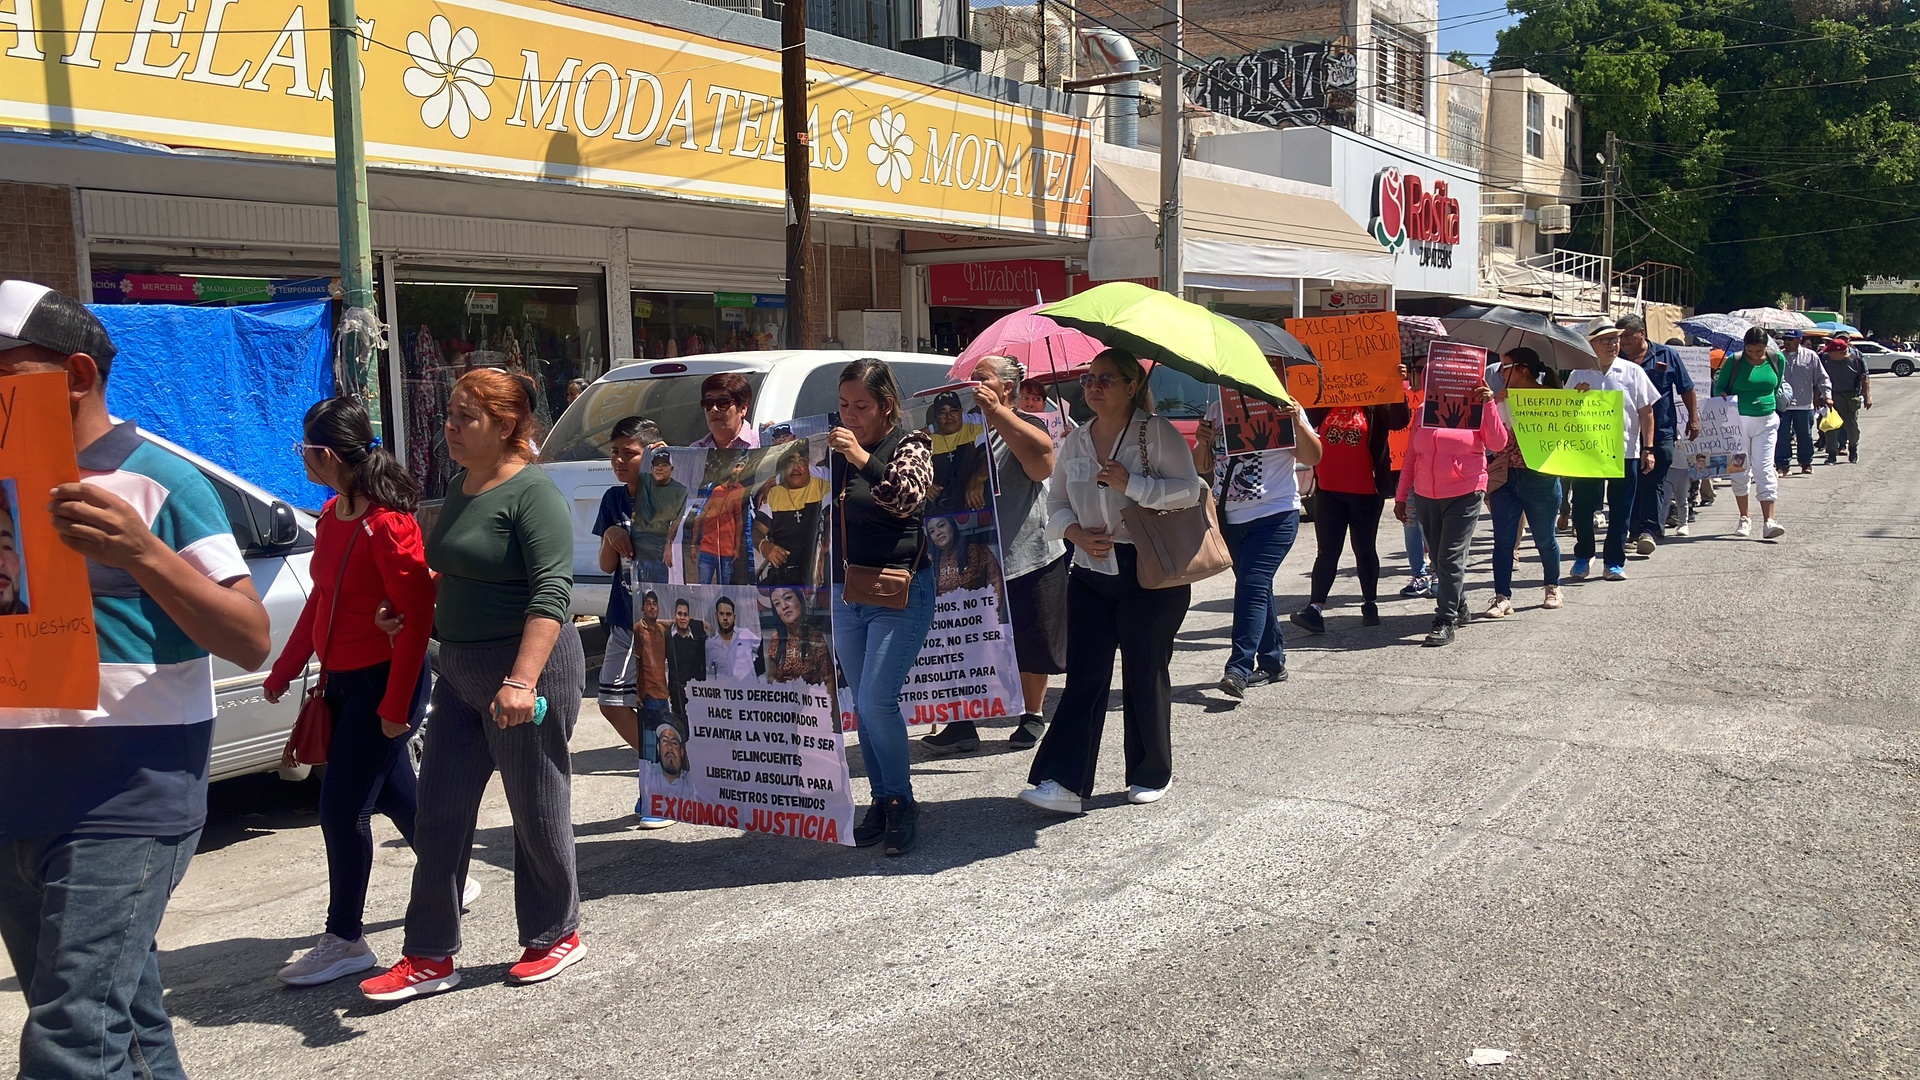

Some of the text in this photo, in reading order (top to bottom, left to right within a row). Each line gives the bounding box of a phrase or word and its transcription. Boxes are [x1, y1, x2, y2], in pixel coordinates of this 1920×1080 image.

[505, 49, 854, 172] MODATELAS
[1404, 174, 1460, 245] Rosita
[963, 262, 1039, 292] Elizabeth
[142, 283, 183, 291] MERCERÍA
[206, 285, 265, 294] MANUALIDADES
[279, 285, 326, 294] TEMPORADAS
[1346, 292, 1378, 305] Rosita
[1295, 314, 1385, 339] EXIGIMOS
[1304, 333, 1399, 362] IBERACION
[1298, 372, 1315, 387] De
[1565, 398, 1584, 407] PARA
[1587, 399, 1602, 407] LOS
[1518, 422, 1612, 433] ALTO AL GOBIERNO
[1720, 425, 1743, 439] para
[1700, 438, 1721, 453] papá
[1722, 437, 1743, 452] José
[963, 599, 978, 610] NO
[981, 596, 994, 606] TE
[16, 615, 91, 640] nuestros
[929, 615, 982, 631] CIONADOR
[947, 635, 961, 647] NO
[965, 633, 979, 644] ES
[983, 630, 1001, 641] SER
[914, 669, 966, 684] ABSOLUTA
[970, 666, 996, 677] PARA
[215, 689, 291, 710] HRYSR
[692, 686, 828, 708] EXIGIR TUS DERECHOS, NO TE
[931, 684, 988, 699] DETENIDOS
[708, 707, 818, 727] HACE EXTORCIONADOR
[909, 697, 1006, 725] JUSTICIA
[694, 726, 834, 751] LEVANTAR LA VOZ, NO ES SER
[732, 750, 803, 767] DELINCUENTES
[706, 766, 834, 792] LIBERTAD ABSOLUTA PARA
[719, 787, 825, 811] NUESTROS DETENIDOS
[651, 794, 839, 843] EXIGIMOS JUSTICIA
